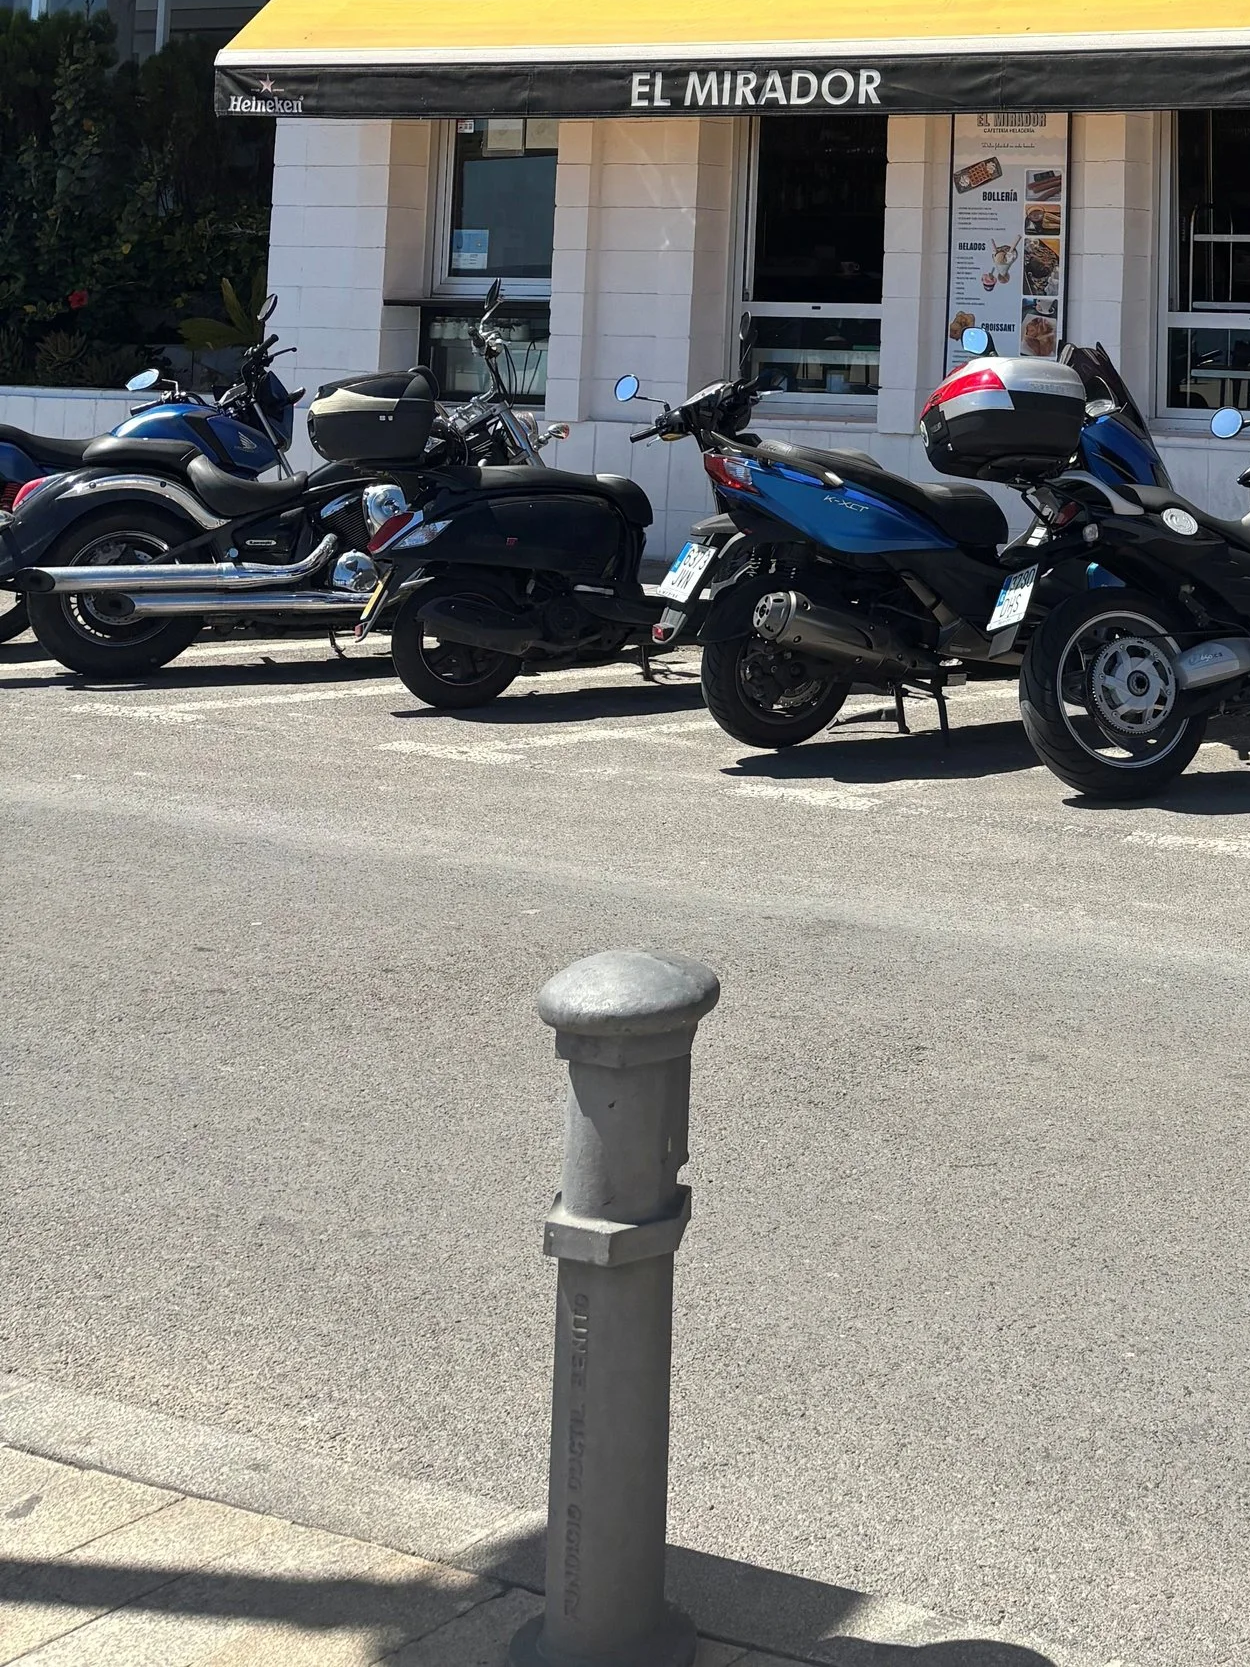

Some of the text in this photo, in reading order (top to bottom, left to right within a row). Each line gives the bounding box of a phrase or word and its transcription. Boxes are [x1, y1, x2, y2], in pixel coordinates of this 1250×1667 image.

[630, 68, 882, 107] EL MIRADOR
[227, 95, 303, 113] Heineken
[982, 189, 1018, 202] BOLLERÍA
[823, 494, 869, 512] K-XCT
[571, 1291, 590, 1390] BENITO
